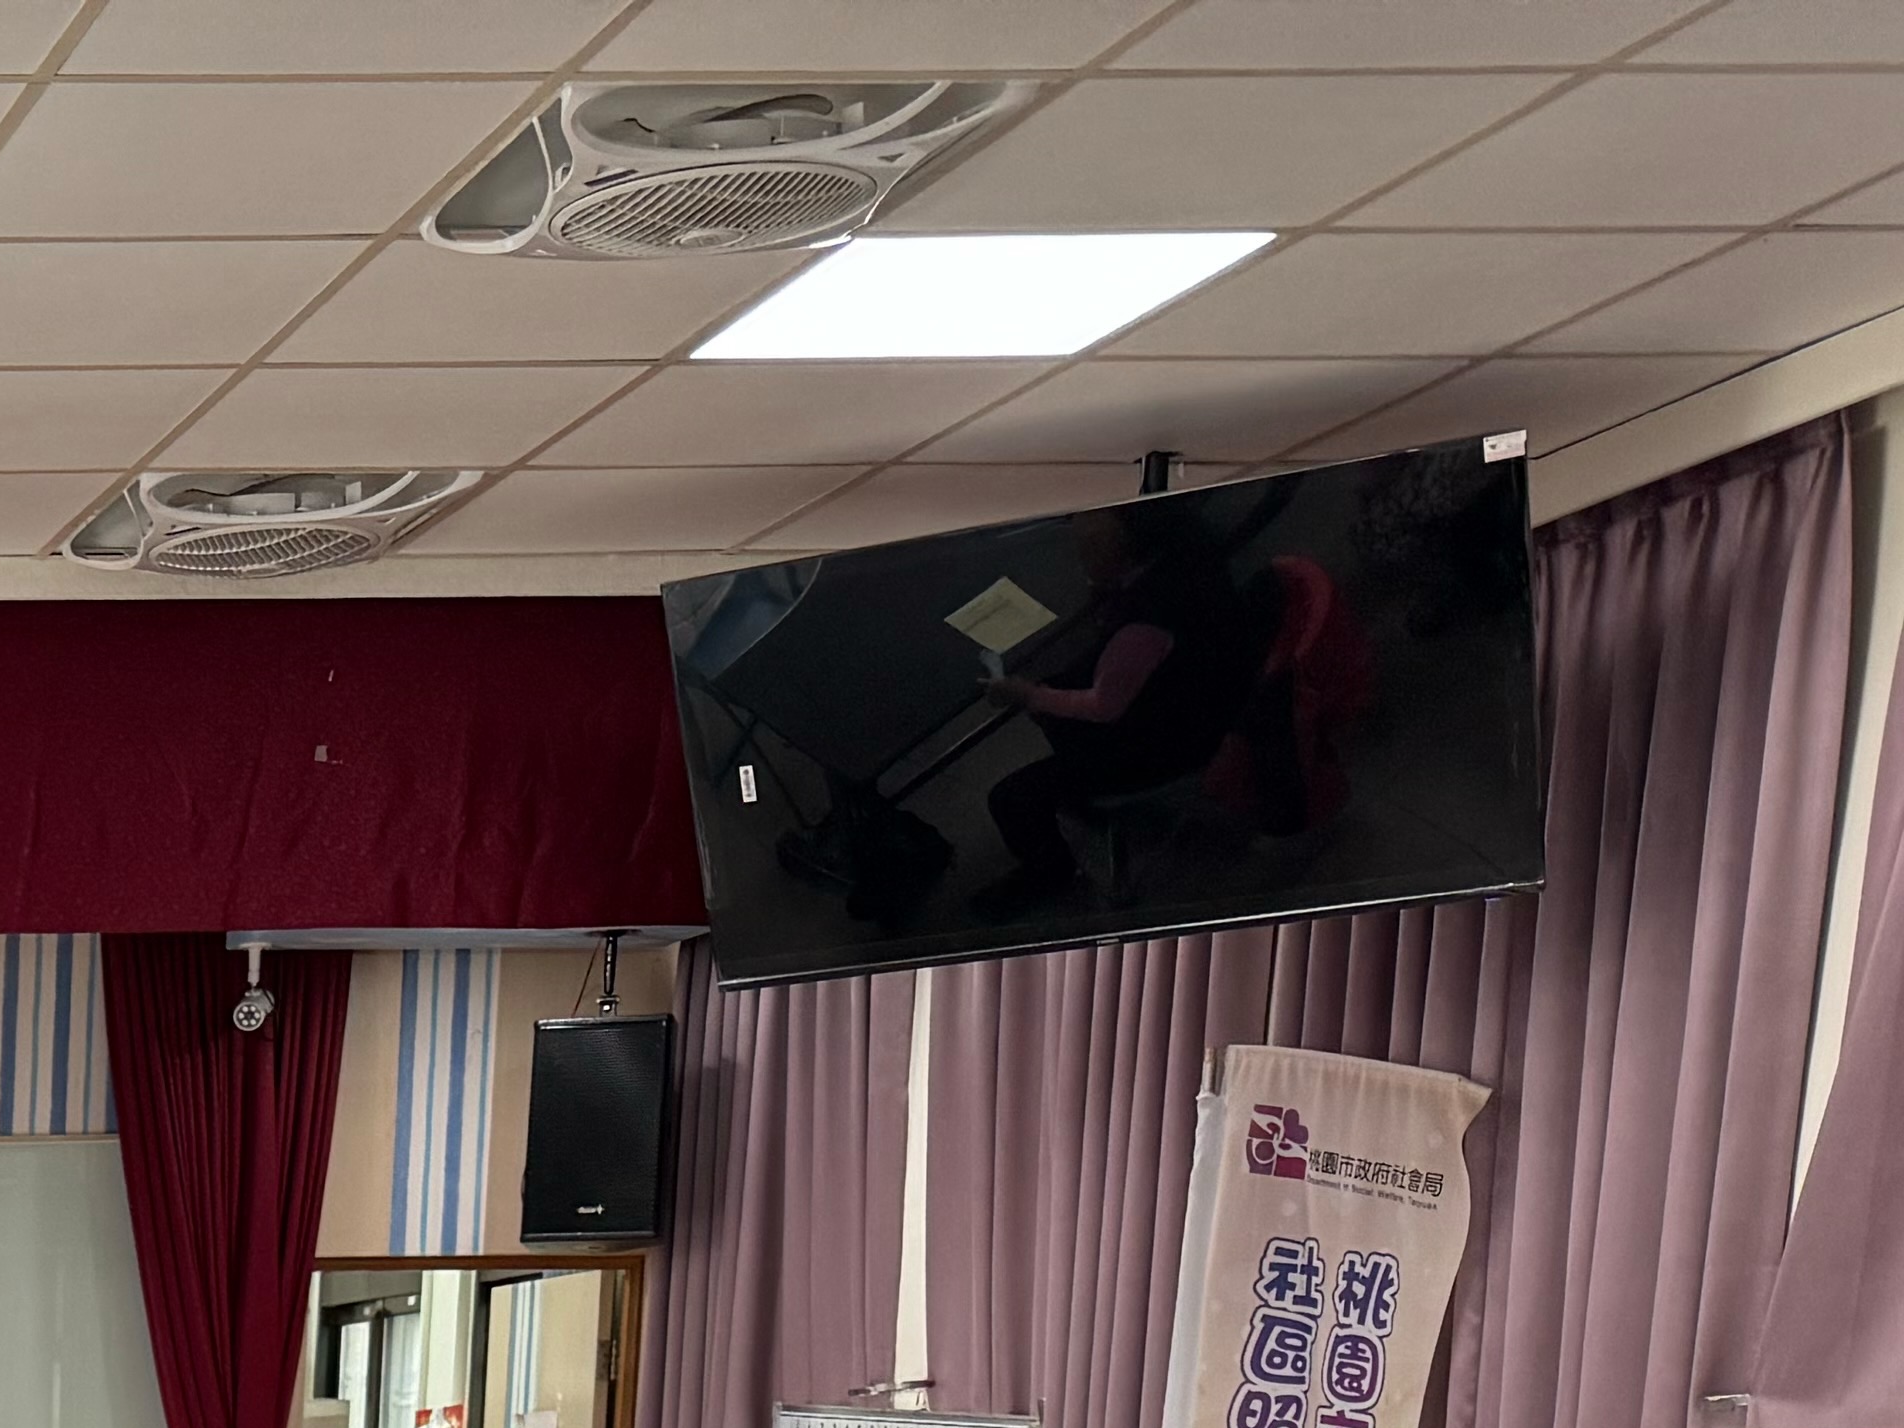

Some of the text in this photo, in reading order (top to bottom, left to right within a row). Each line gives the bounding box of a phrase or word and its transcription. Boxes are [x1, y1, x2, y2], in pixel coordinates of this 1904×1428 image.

[1308, 1149, 1445, 1198] 桃園市政府社會局
